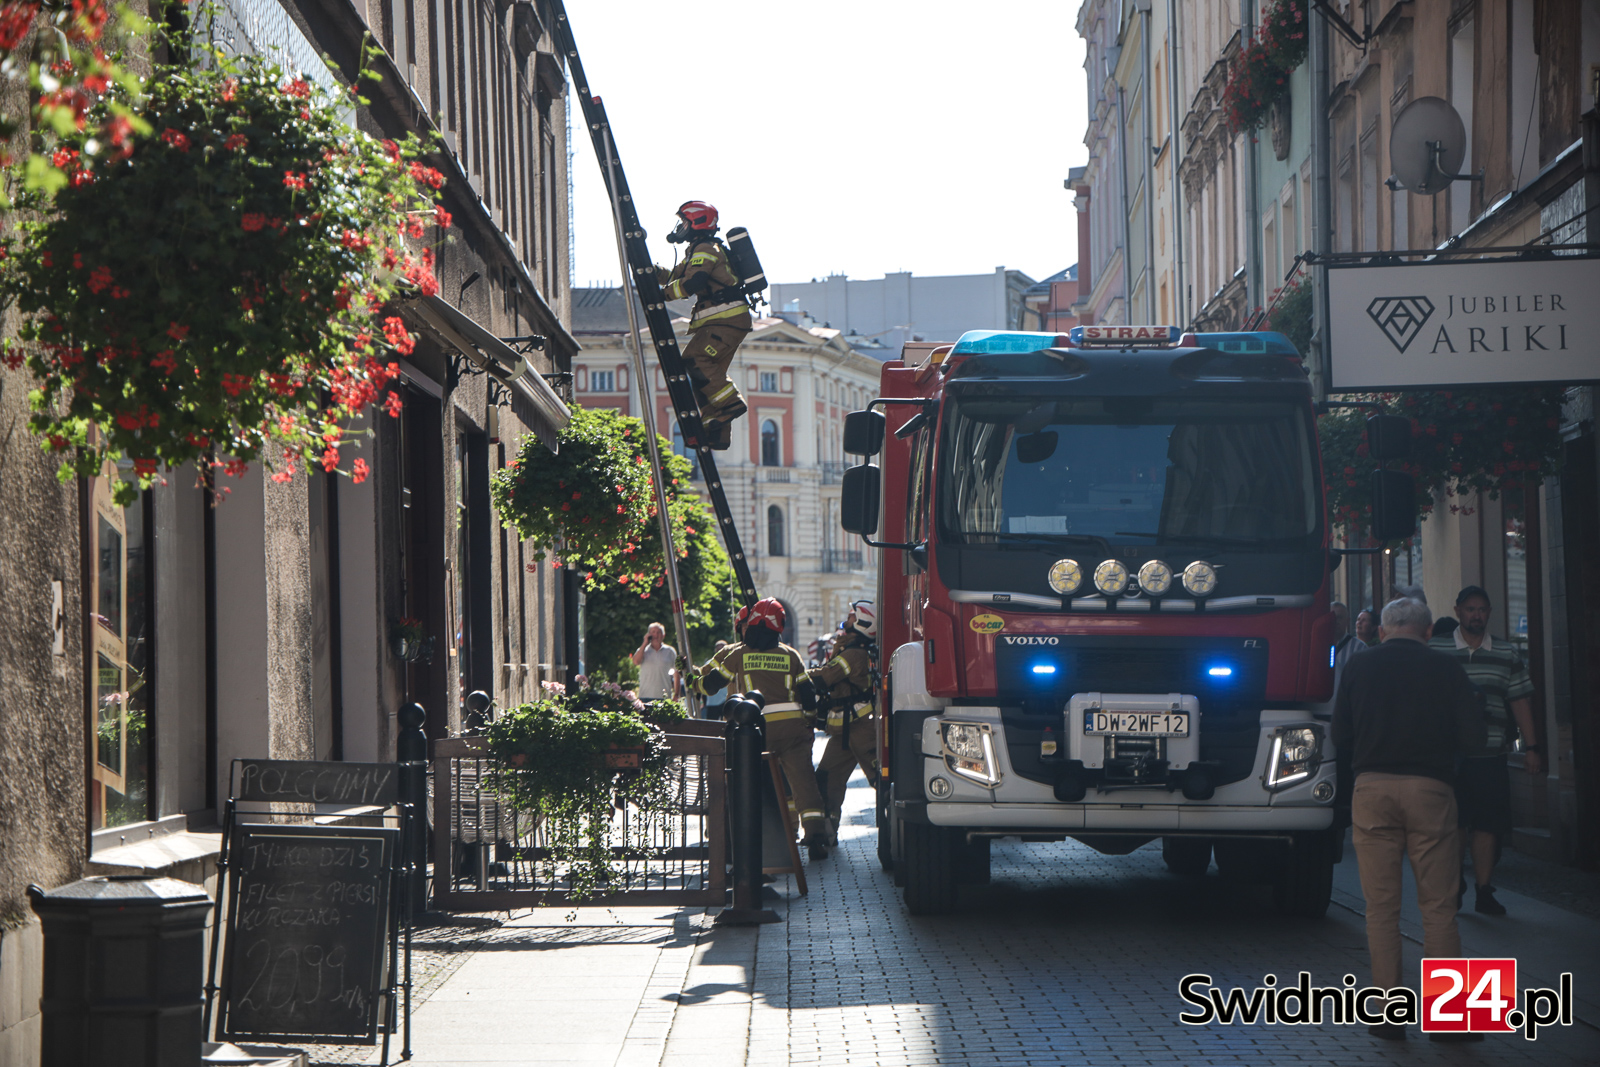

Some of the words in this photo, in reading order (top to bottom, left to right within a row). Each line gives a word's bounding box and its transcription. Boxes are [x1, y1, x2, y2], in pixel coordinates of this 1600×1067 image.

[1447, 294, 1567, 320] JUBILER
[1429, 324, 1568, 354] ARIKI
[972, 619, 1003, 629] bocar
[1004, 636, 1059, 646] VOLVO
[1243, 639, 1262, 648] FL
[1097, 714, 1120, 731] DW
[1127, 715, 1183, 732] 2WF12
[248, 843, 310, 870] TYLKO
[245, 881, 305, 904] FILET
